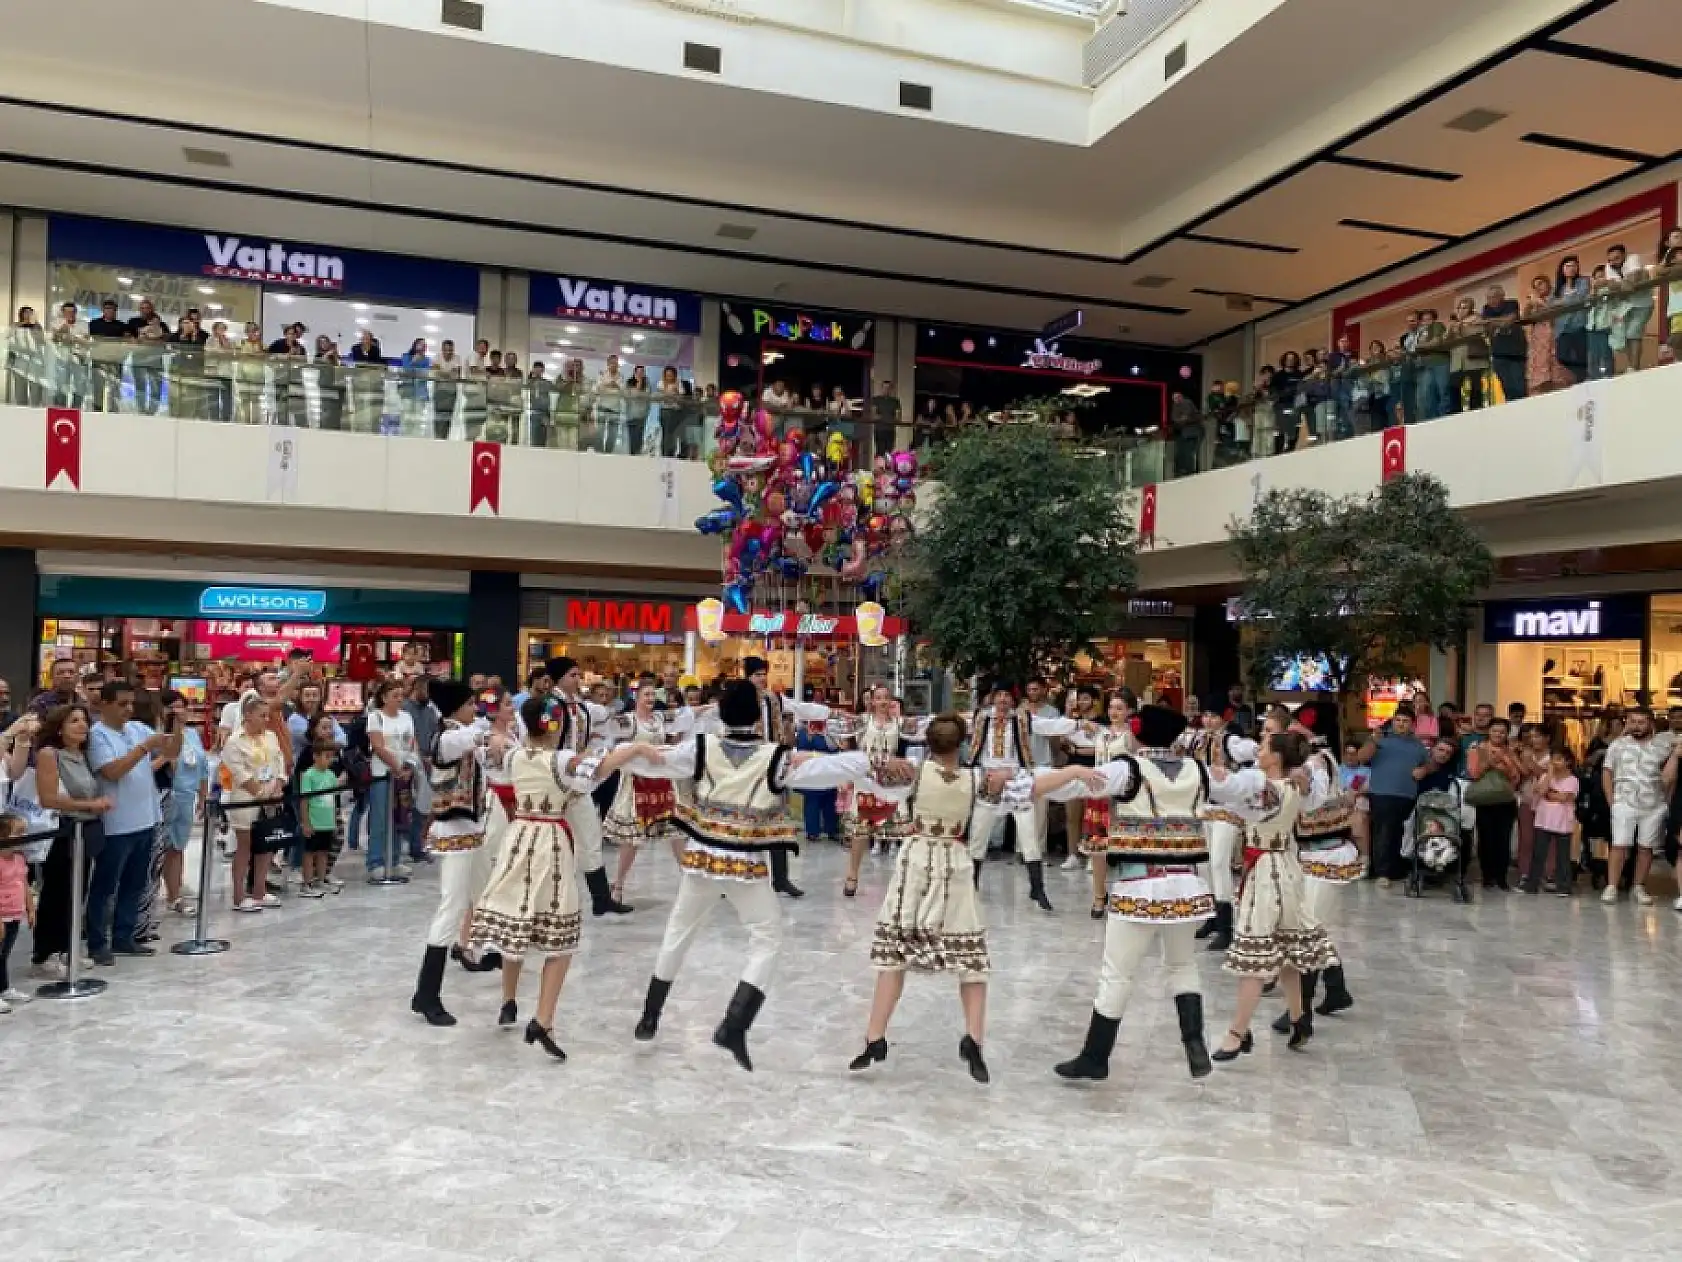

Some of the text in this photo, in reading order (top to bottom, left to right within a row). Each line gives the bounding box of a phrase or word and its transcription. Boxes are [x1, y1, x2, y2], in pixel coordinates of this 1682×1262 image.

[204, 235, 344, 280] Vatan
[558, 277, 677, 321] Vatan
[216, 593, 309, 610] watsons
[567, 598, 671, 632] MMM
[1514, 600, 1602, 636] mavi
